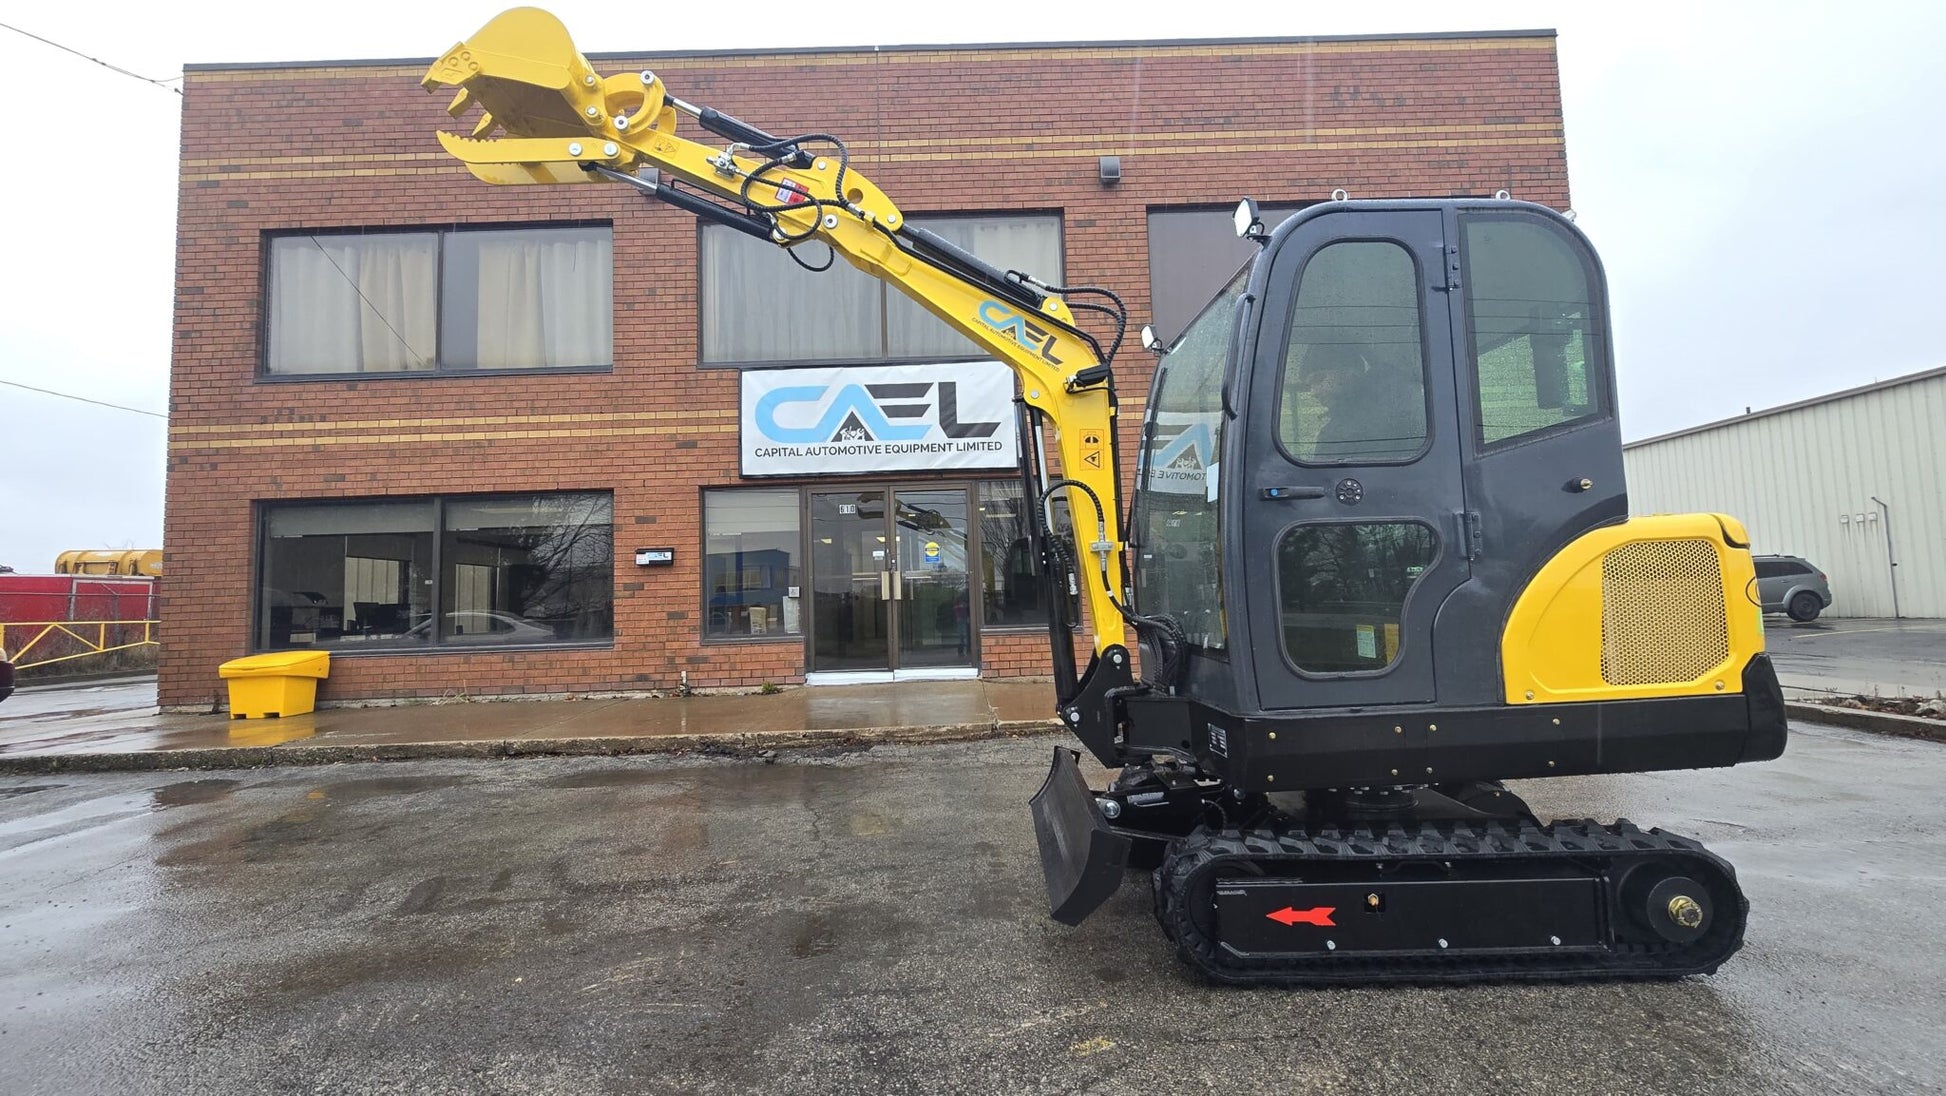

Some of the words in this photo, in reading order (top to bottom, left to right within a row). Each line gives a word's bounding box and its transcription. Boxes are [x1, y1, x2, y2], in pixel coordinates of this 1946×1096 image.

[979, 300, 1064, 365] CAEL
[755, 381, 1001, 443] CAEL
[755, 447, 803, 458] CAPITAL
[805, 445, 882, 456] AUTOMOTIVE
[885, 443, 953, 455] EQUIPMENT
[956, 441, 1003, 452] LIMITED
